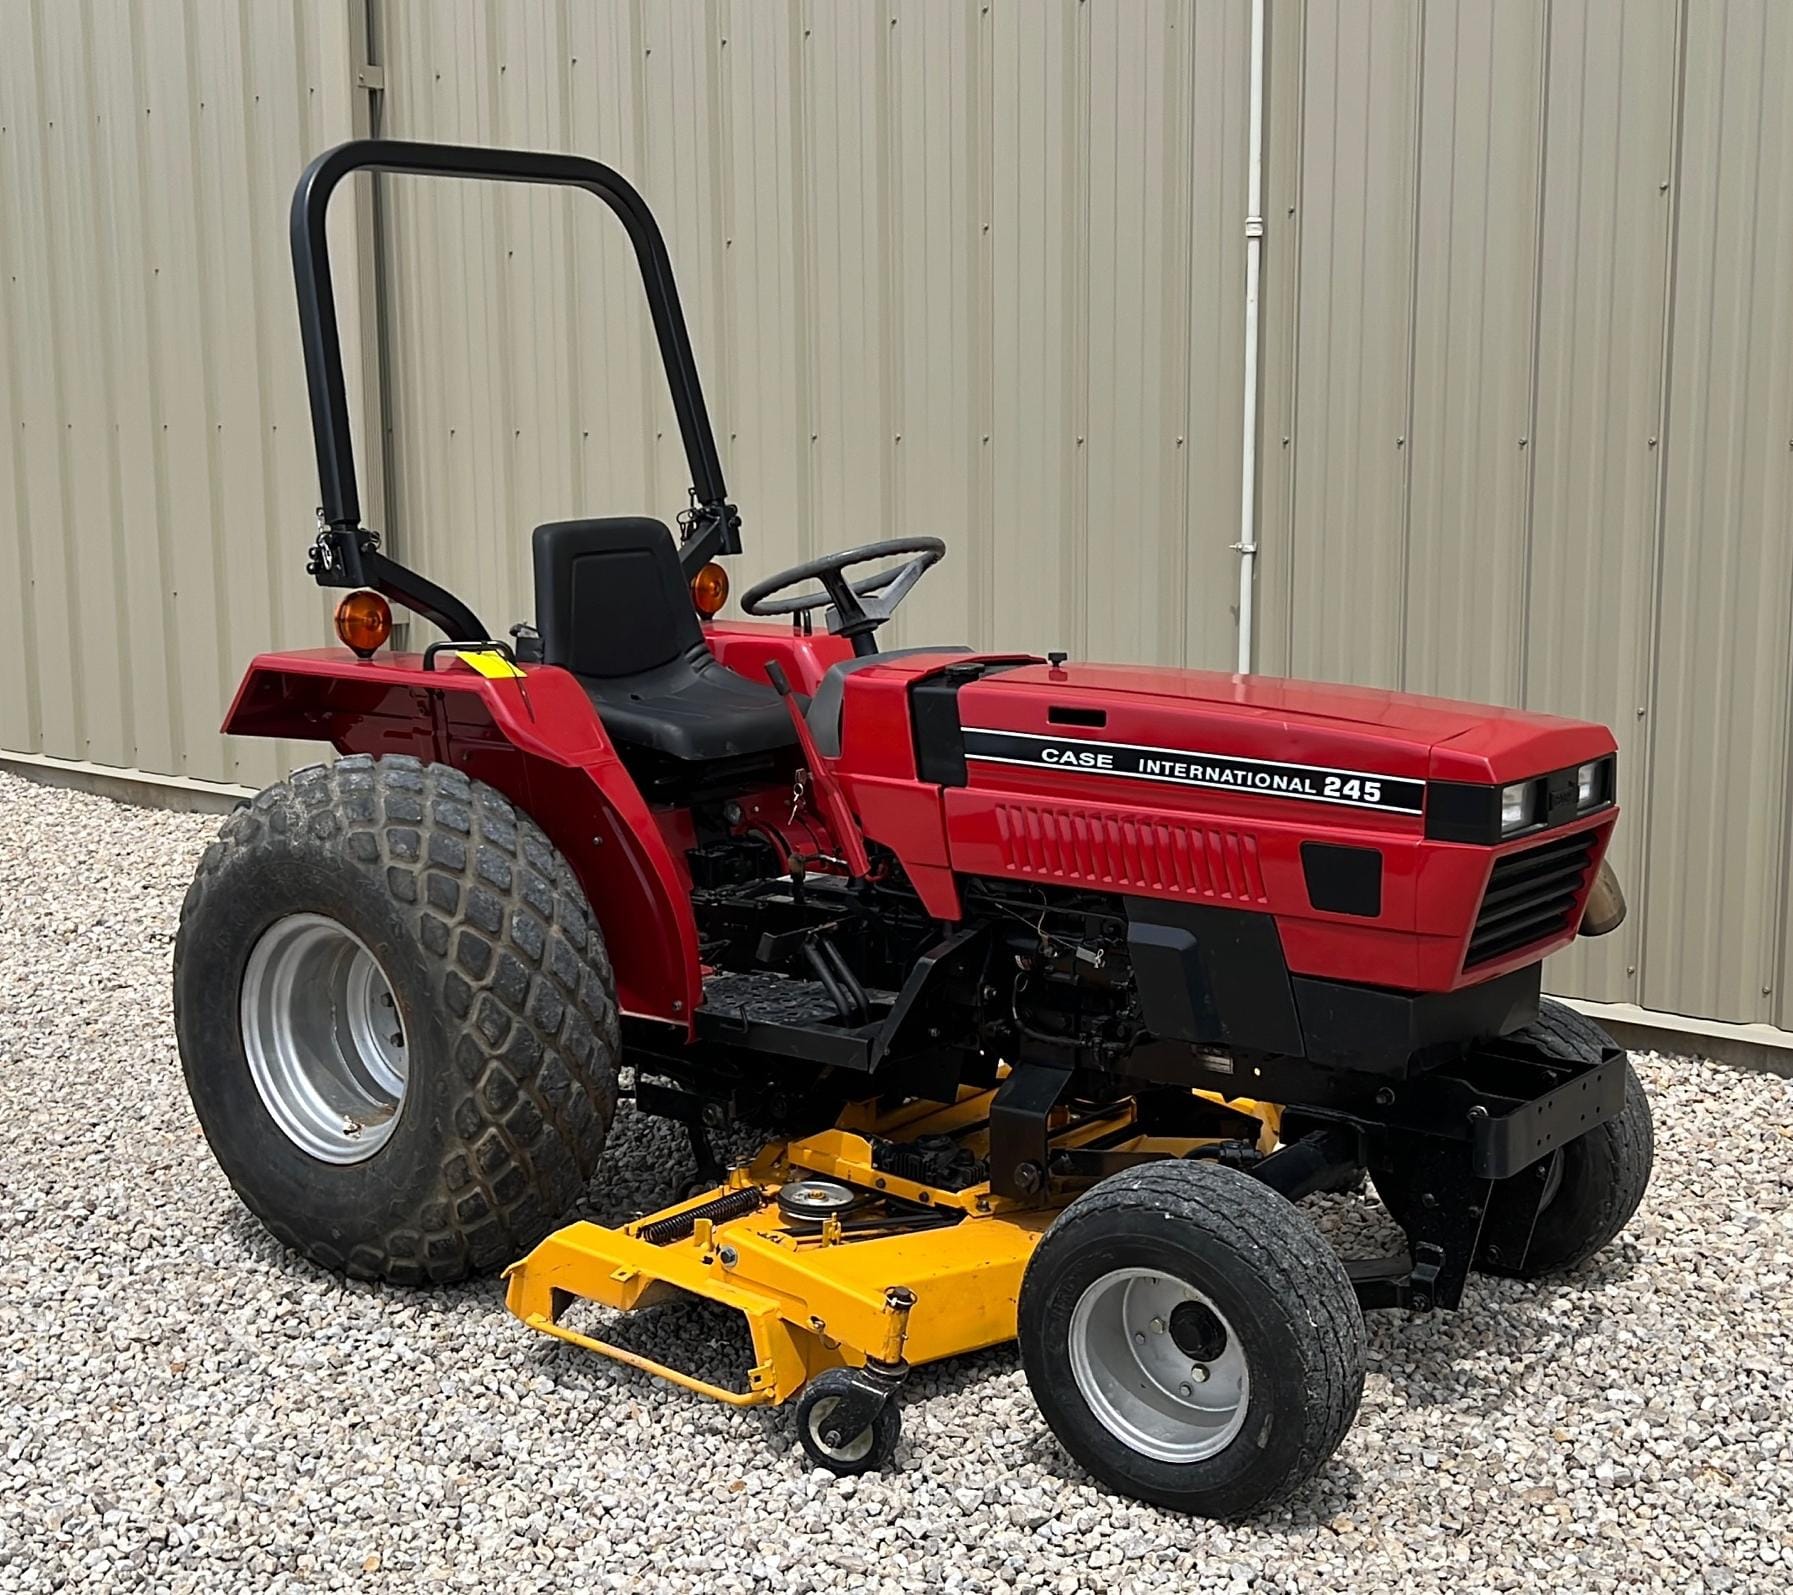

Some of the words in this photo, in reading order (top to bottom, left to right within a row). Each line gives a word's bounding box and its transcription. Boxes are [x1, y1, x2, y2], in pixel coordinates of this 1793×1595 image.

[1041, 748, 1114, 769] CASE
[1138, 758, 1317, 795] INTERNATIONAL
[1323, 776, 1381, 802] 245
